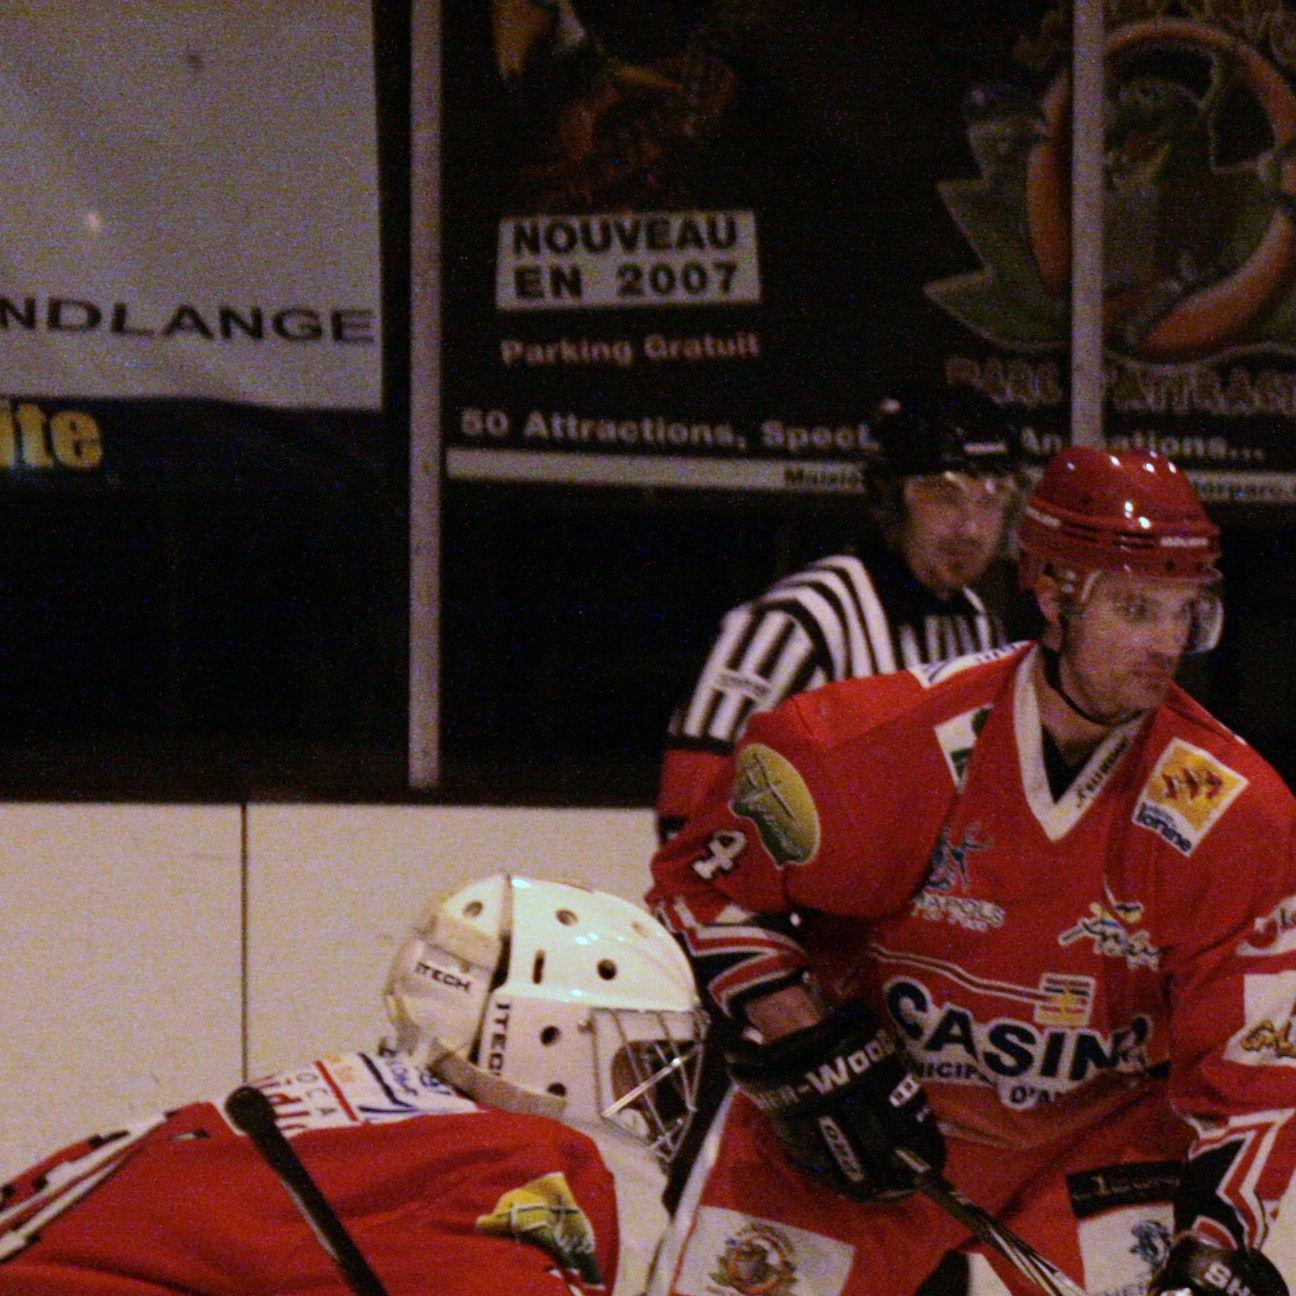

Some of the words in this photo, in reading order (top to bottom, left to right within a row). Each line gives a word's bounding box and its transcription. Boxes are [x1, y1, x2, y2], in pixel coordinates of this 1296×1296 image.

[511, 216, 739, 255] NOUVEAU
[513, 265, 584, 299] EN
[614, 262, 739, 298] 2007
[500, 338, 634, 367] Parking
[643, 332, 760, 362] Gratuit
